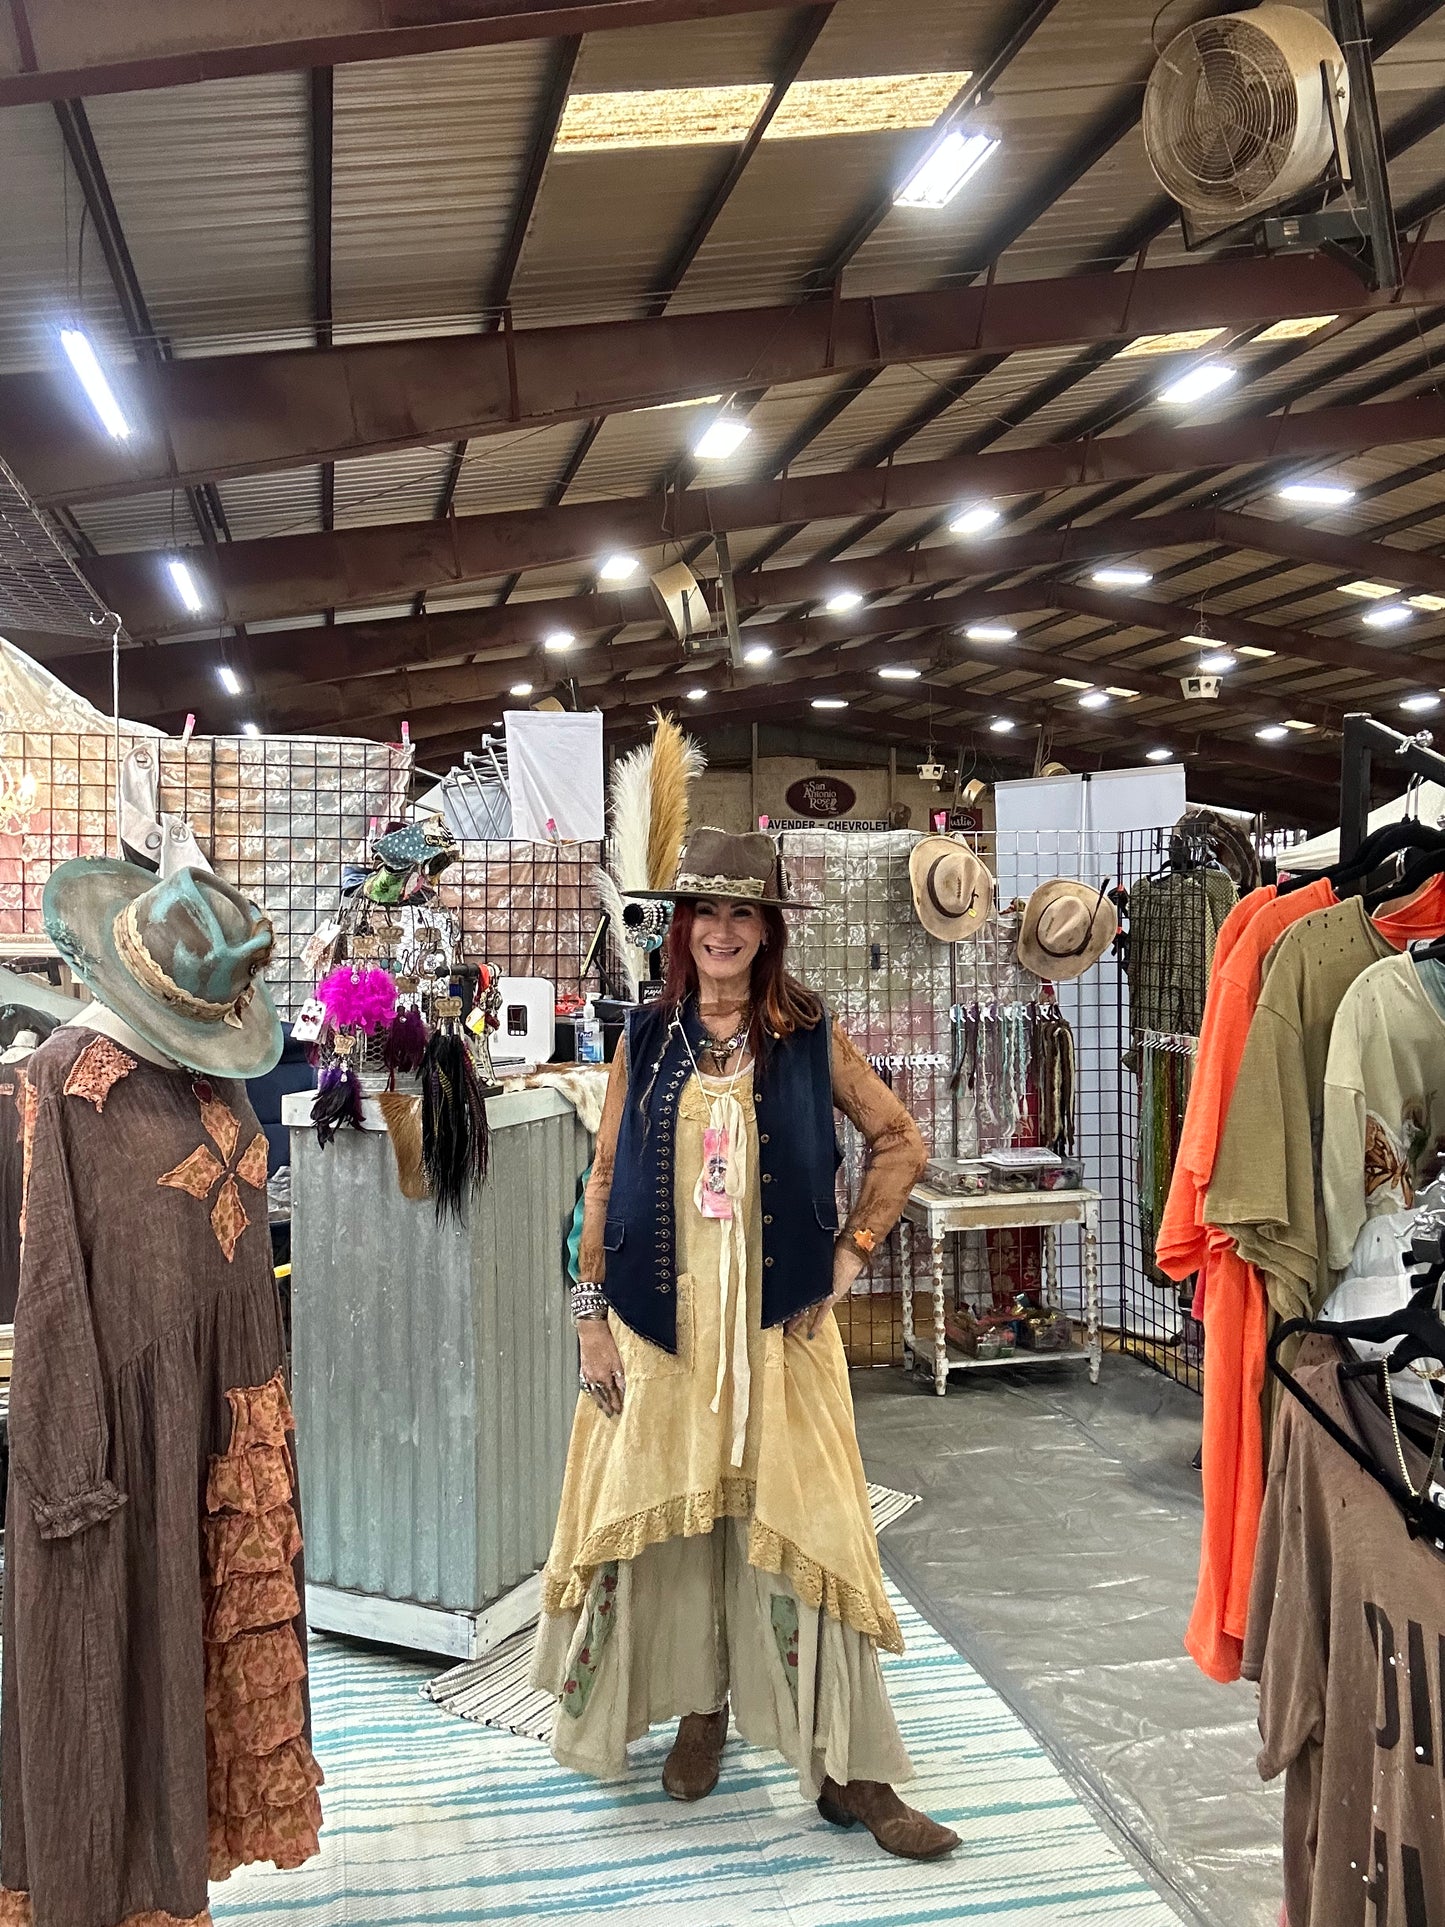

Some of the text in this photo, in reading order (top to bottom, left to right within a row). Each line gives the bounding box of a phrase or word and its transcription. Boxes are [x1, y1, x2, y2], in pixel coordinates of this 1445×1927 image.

[809, 781, 826, 792] San
[803, 787, 837, 798] Antonio
[809, 797, 831, 811] Rose
[766, 820, 816, 829] AVENDER
[827, 821, 888, 831] CHEVROLET
